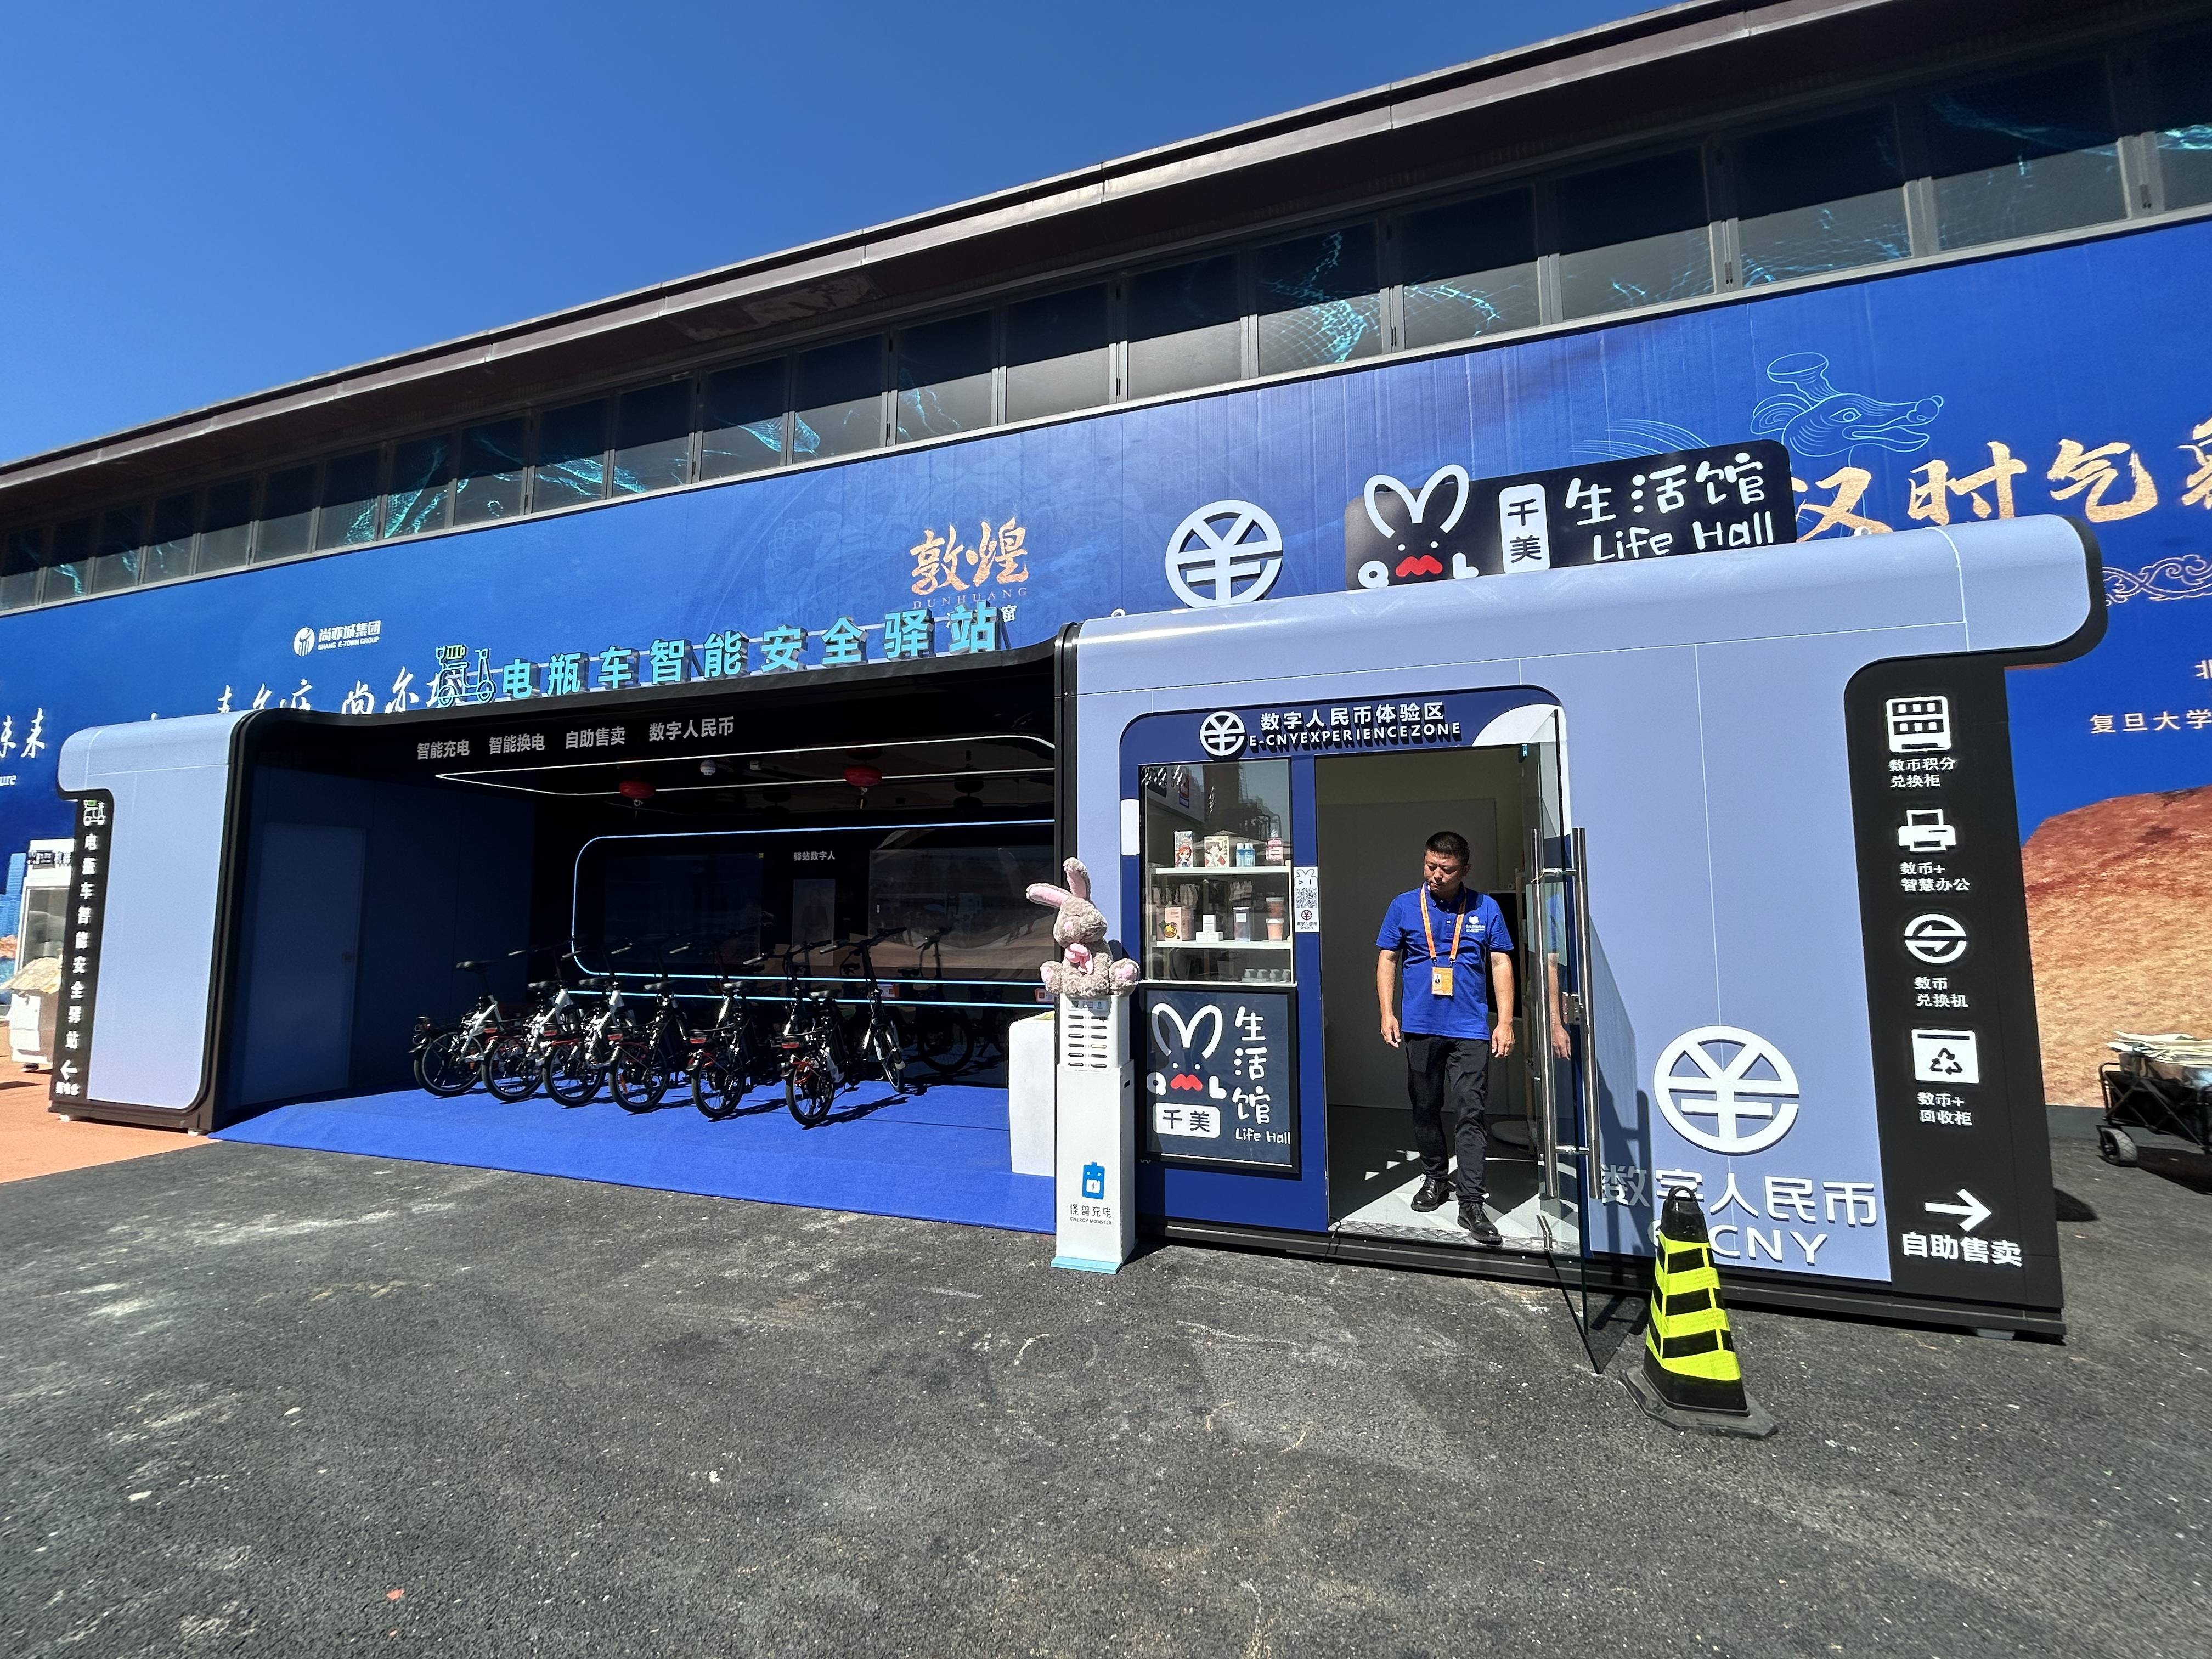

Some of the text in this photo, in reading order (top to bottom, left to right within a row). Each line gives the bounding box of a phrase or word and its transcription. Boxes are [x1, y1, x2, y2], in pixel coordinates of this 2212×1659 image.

[1565, 452, 1763, 526] 生活馆
[1508, 498, 1542, 563] 千美
[1594, 511, 1774, 561] Life Hall
[910, 516, 1029, 595] 敦煌
[913, 587, 1028, 610] DUNHUANG
[318, 620, 382, 642] 尚亦城集团
[318, 642, 337, 651] SHANG
[360, 636, 380, 645] GROUP
[501, 599, 998, 699] 电瓶车智能安全驿站
[1261, 701, 1444, 731] 数字人民币体验区
[2089, 708, 2212, 734] 复旦大学
[417, 715, 735, 760] 智能充电 智能换电 自助售卖 数字人民币
[1889, 757, 1956, 772] 数币积分
[1890, 774, 1941, 788] 兑换柜
[1900, 862, 1945, 876] 数币+
[1900, 878, 1971, 893] 智慧办公
[1914, 977, 1948, 991] 数币
[1916, 994, 1969, 1008] 兑换机
[1232, 1006, 1271, 1124] 生活馆
[1917, 1092, 1965, 1107] 数币+
[1162, 1109, 1210, 1132] 千美
[1920, 1110, 1973, 1126] 回收柜
[1235, 1127, 1291, 1144] Life Hall
[1600, 1164, 1877, 1226] 数字人民币
[1070, 1204, 1111, 1218] 怪兽充电
[1648, 1219, 1828, 1265] CNY
[1901, 1232, 2022, 1268] 自助售卖
